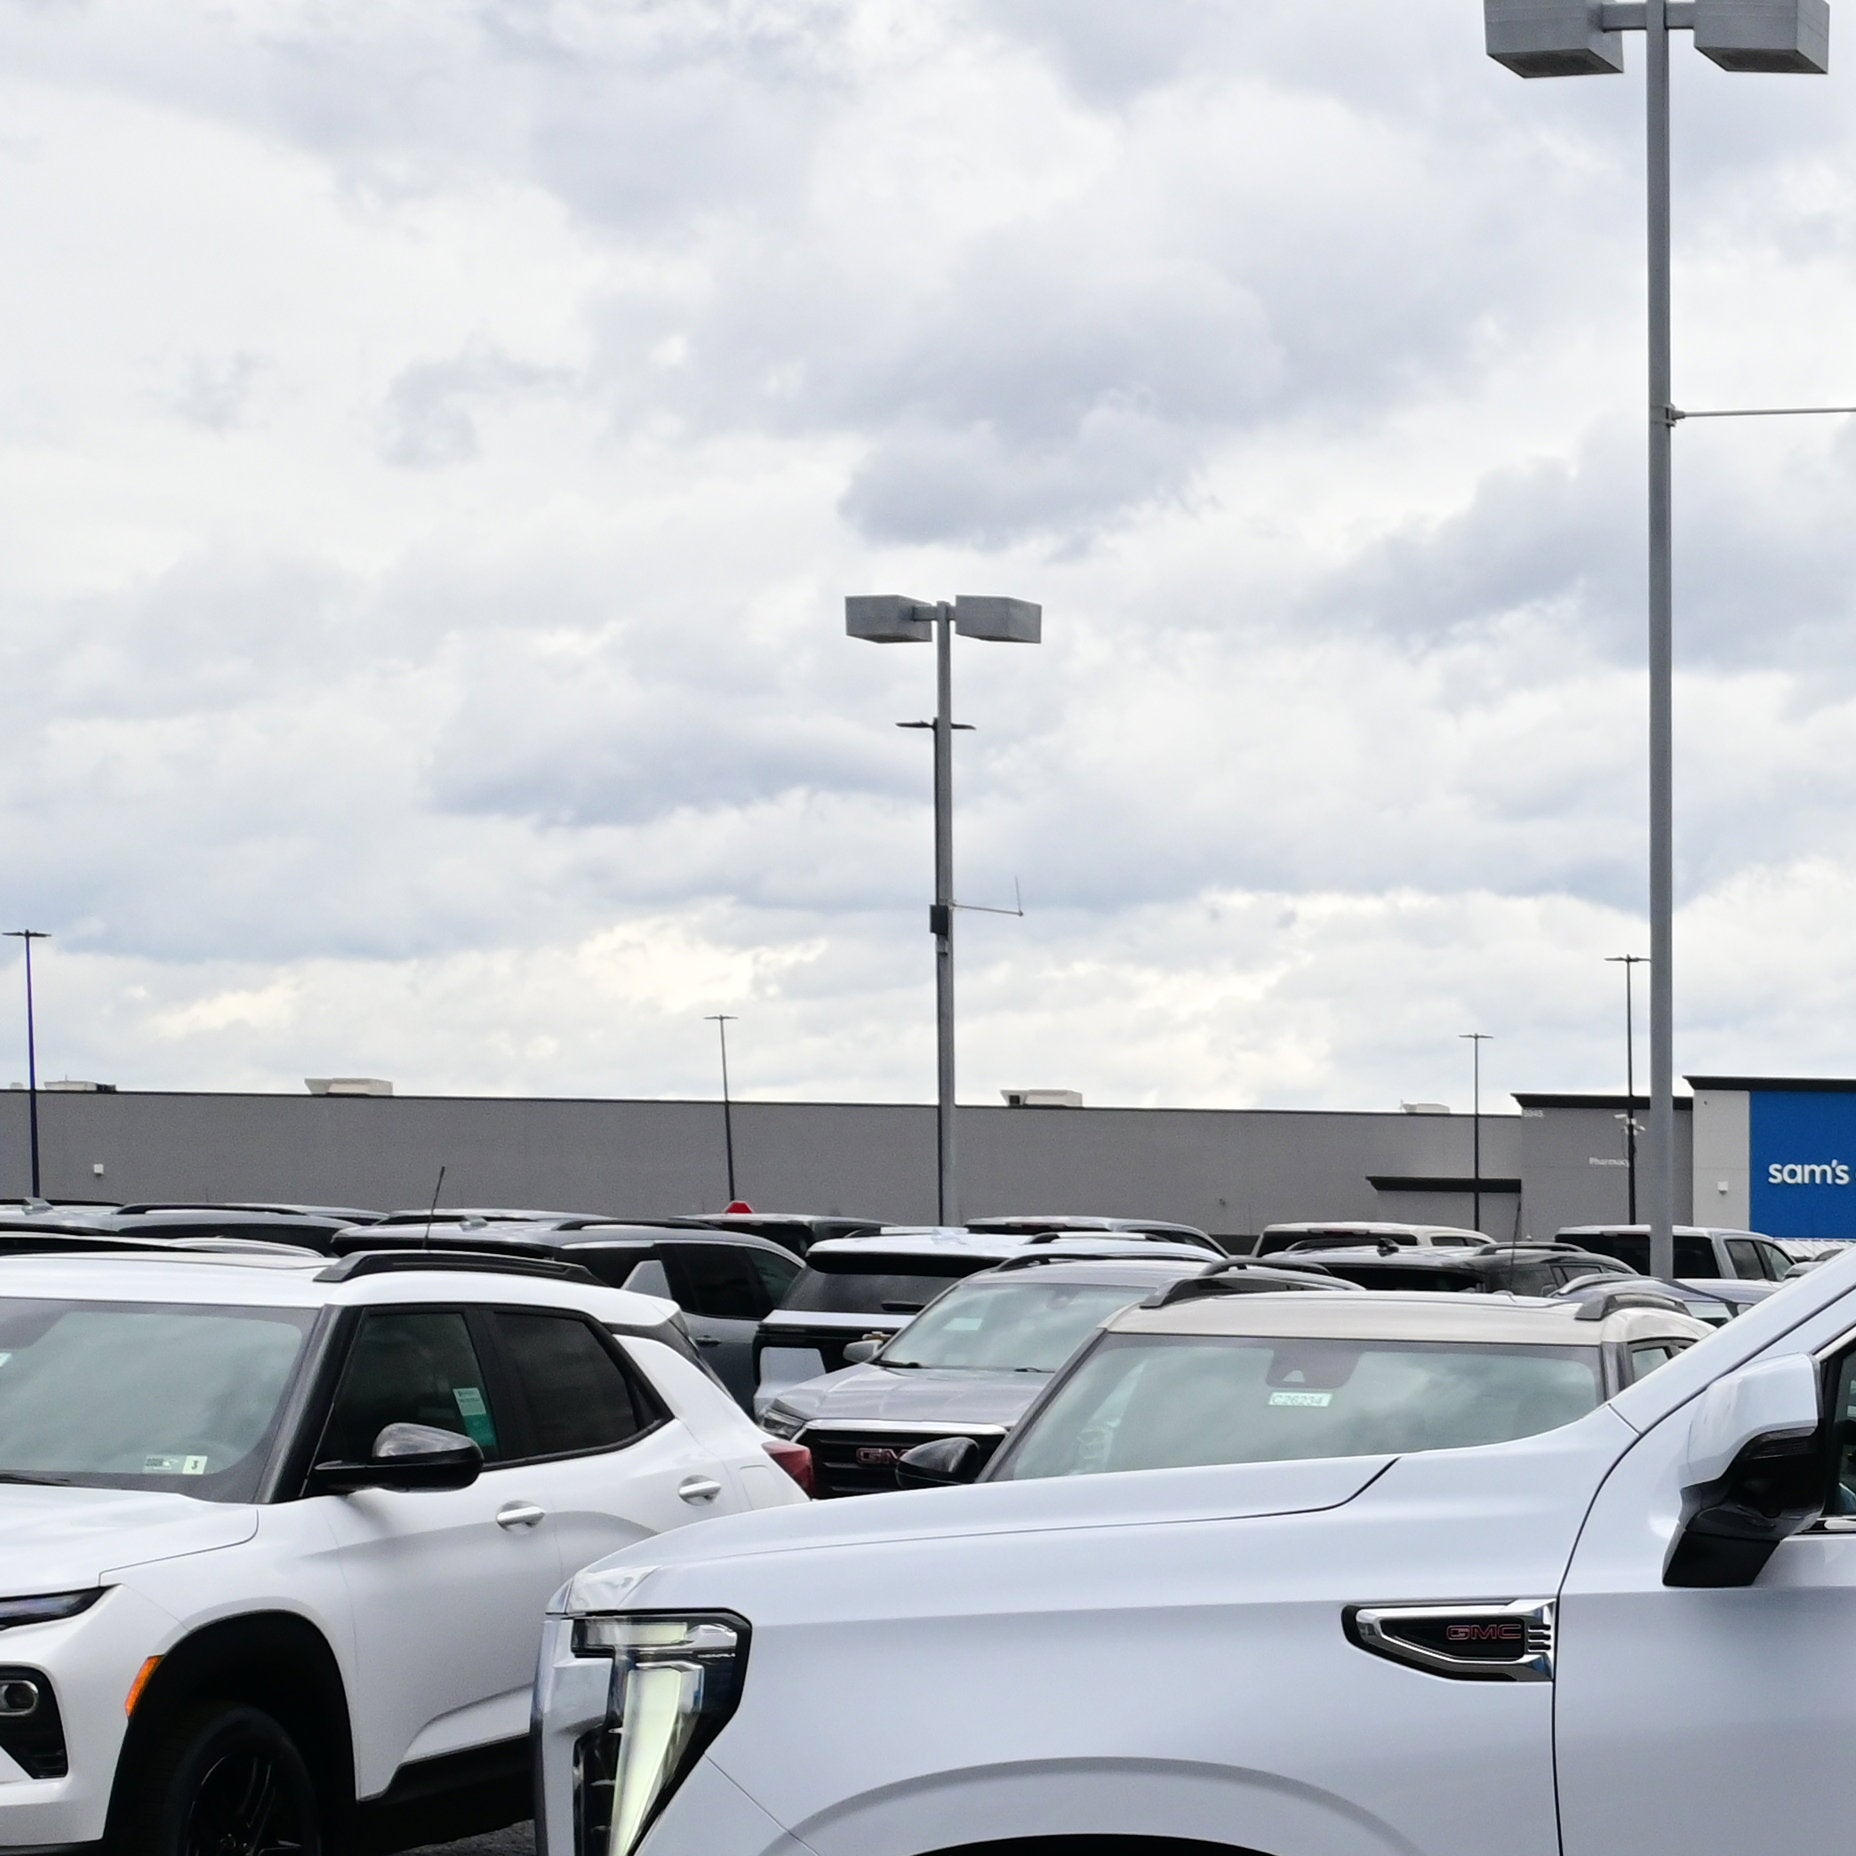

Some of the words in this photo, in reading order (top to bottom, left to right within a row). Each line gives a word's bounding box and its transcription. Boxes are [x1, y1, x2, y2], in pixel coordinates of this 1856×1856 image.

[1768, 1159, 1850, 1185] sam's
[856, 1447, 909, 1464] GM
[1446, 1624, 1522, 1640] GMC
